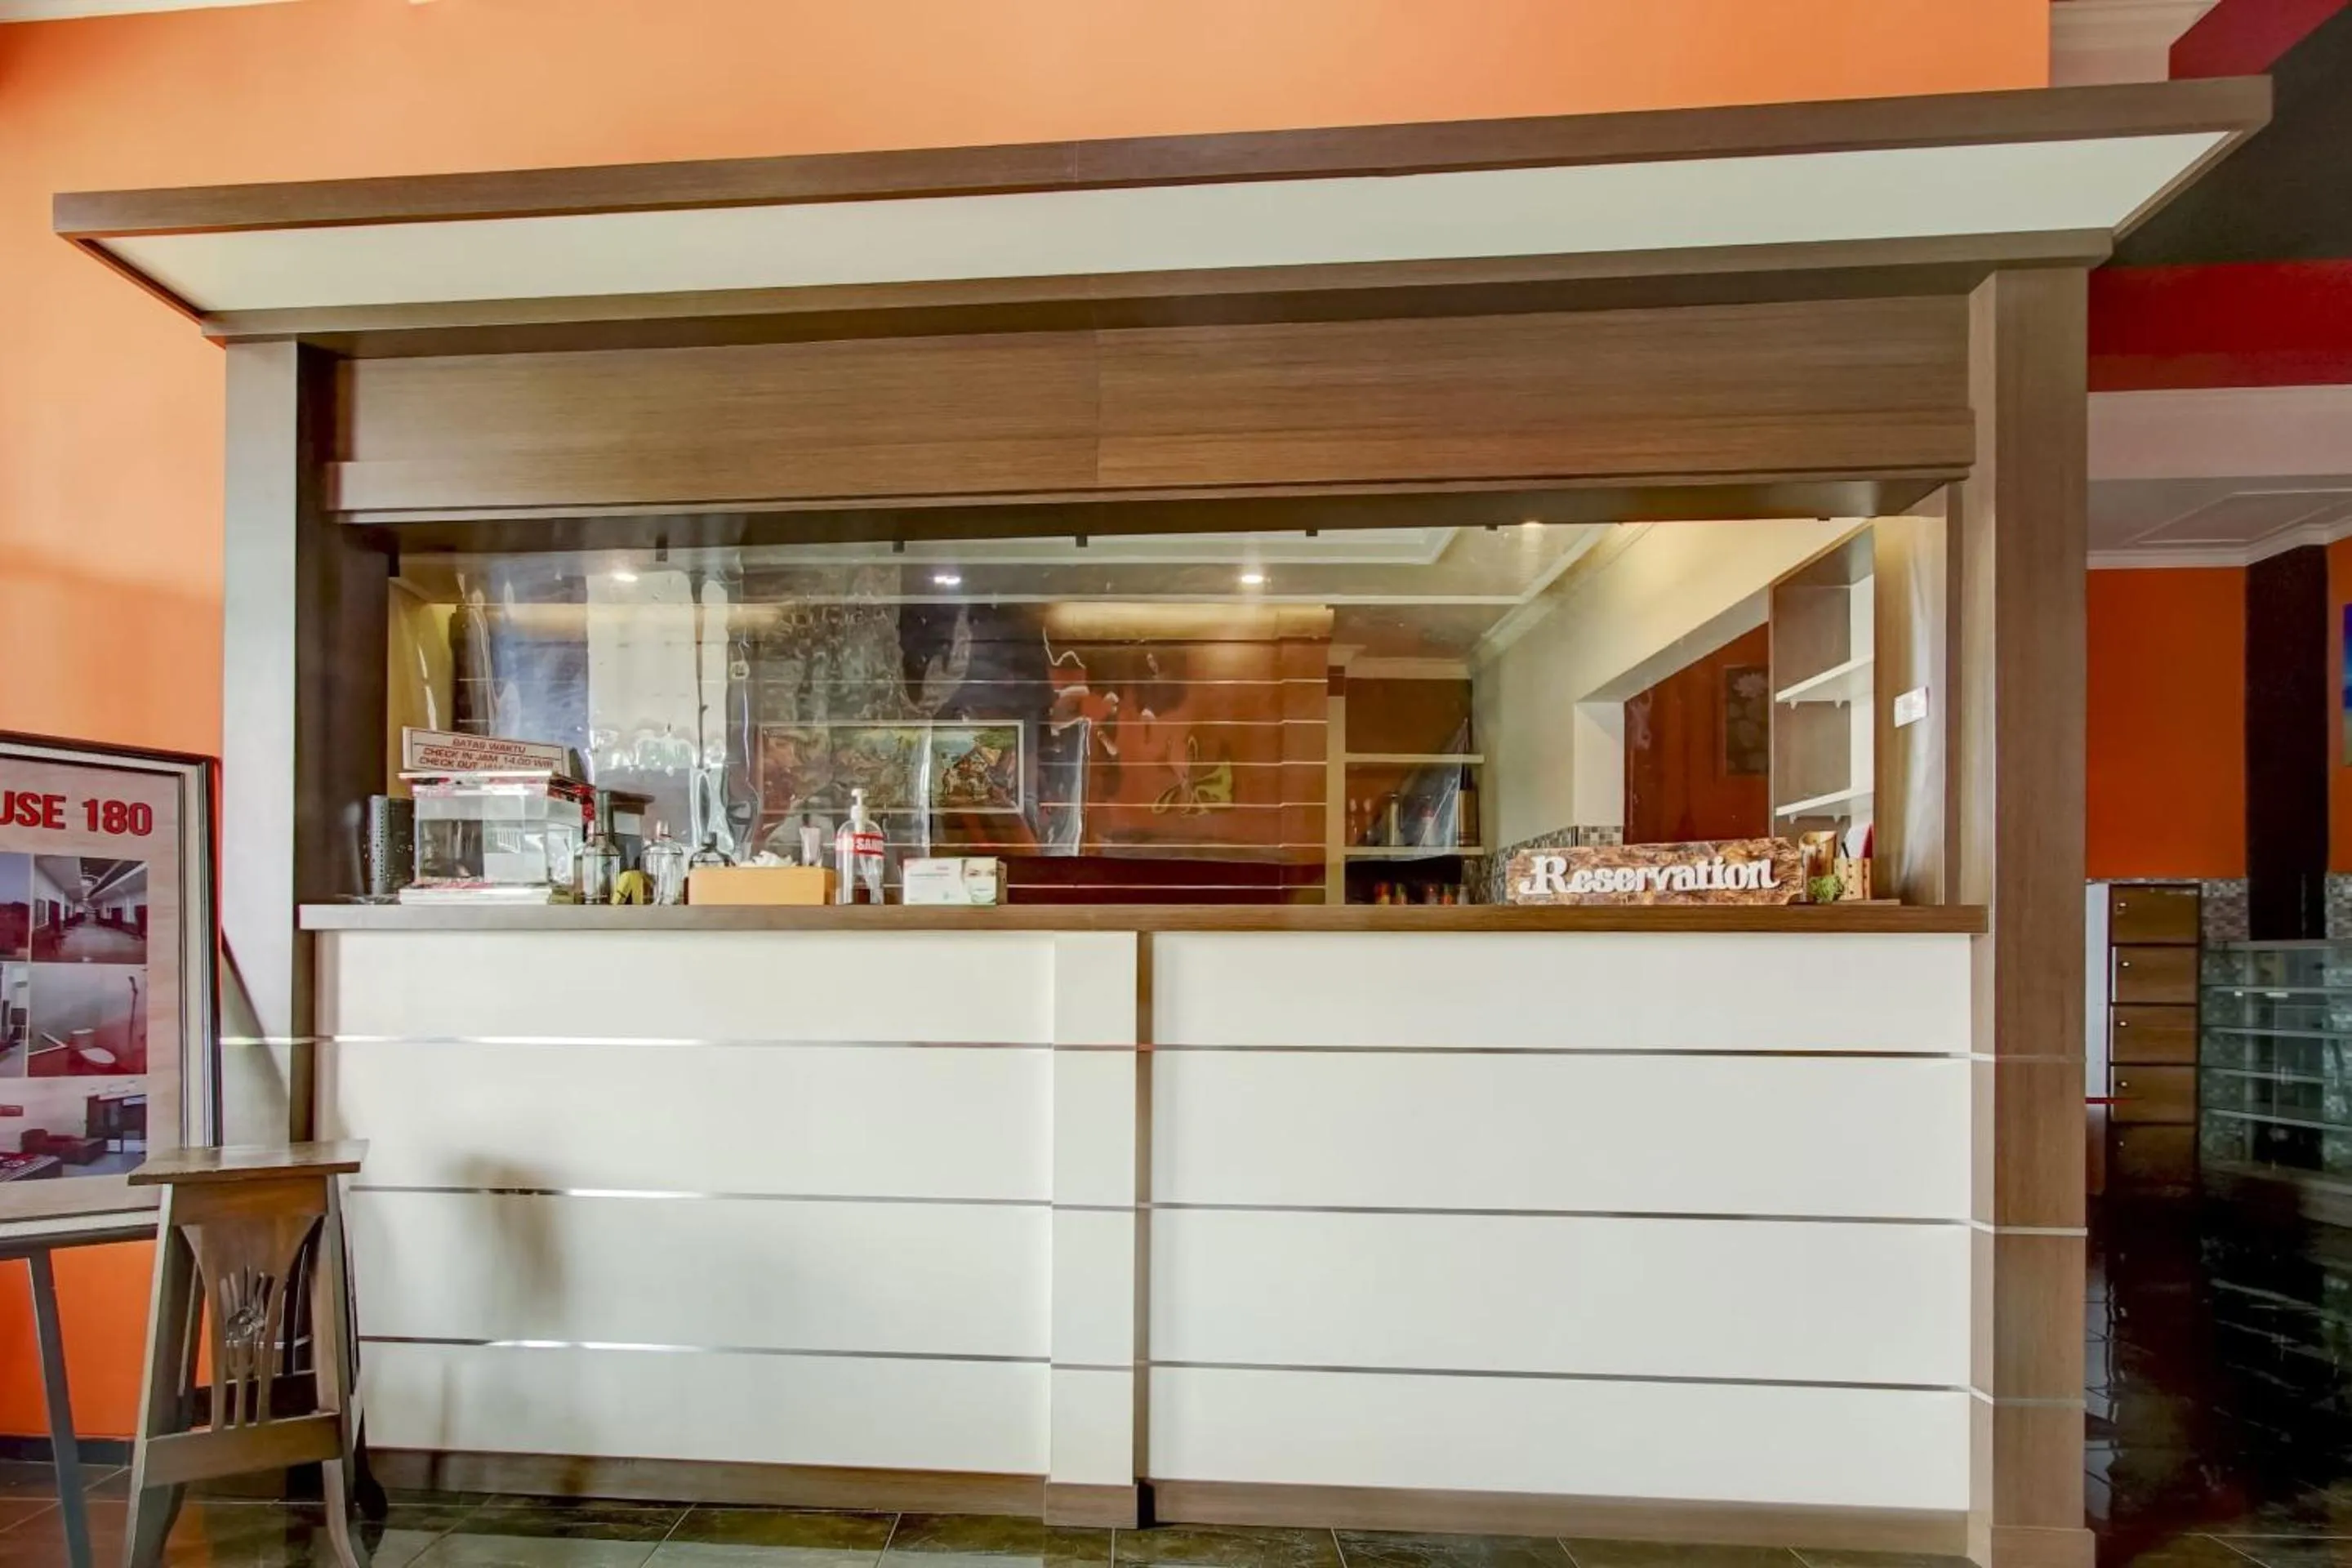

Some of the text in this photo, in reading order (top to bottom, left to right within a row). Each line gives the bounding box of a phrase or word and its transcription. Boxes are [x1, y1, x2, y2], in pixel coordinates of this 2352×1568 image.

[419, 756, 454, 767] CHECK
[457, 760, 477, 769] OUT
[423, 747, 458, 758] CHECK
[82, 799, 153, 836] 180
[1519, 856, 1780, 895] Reservation
